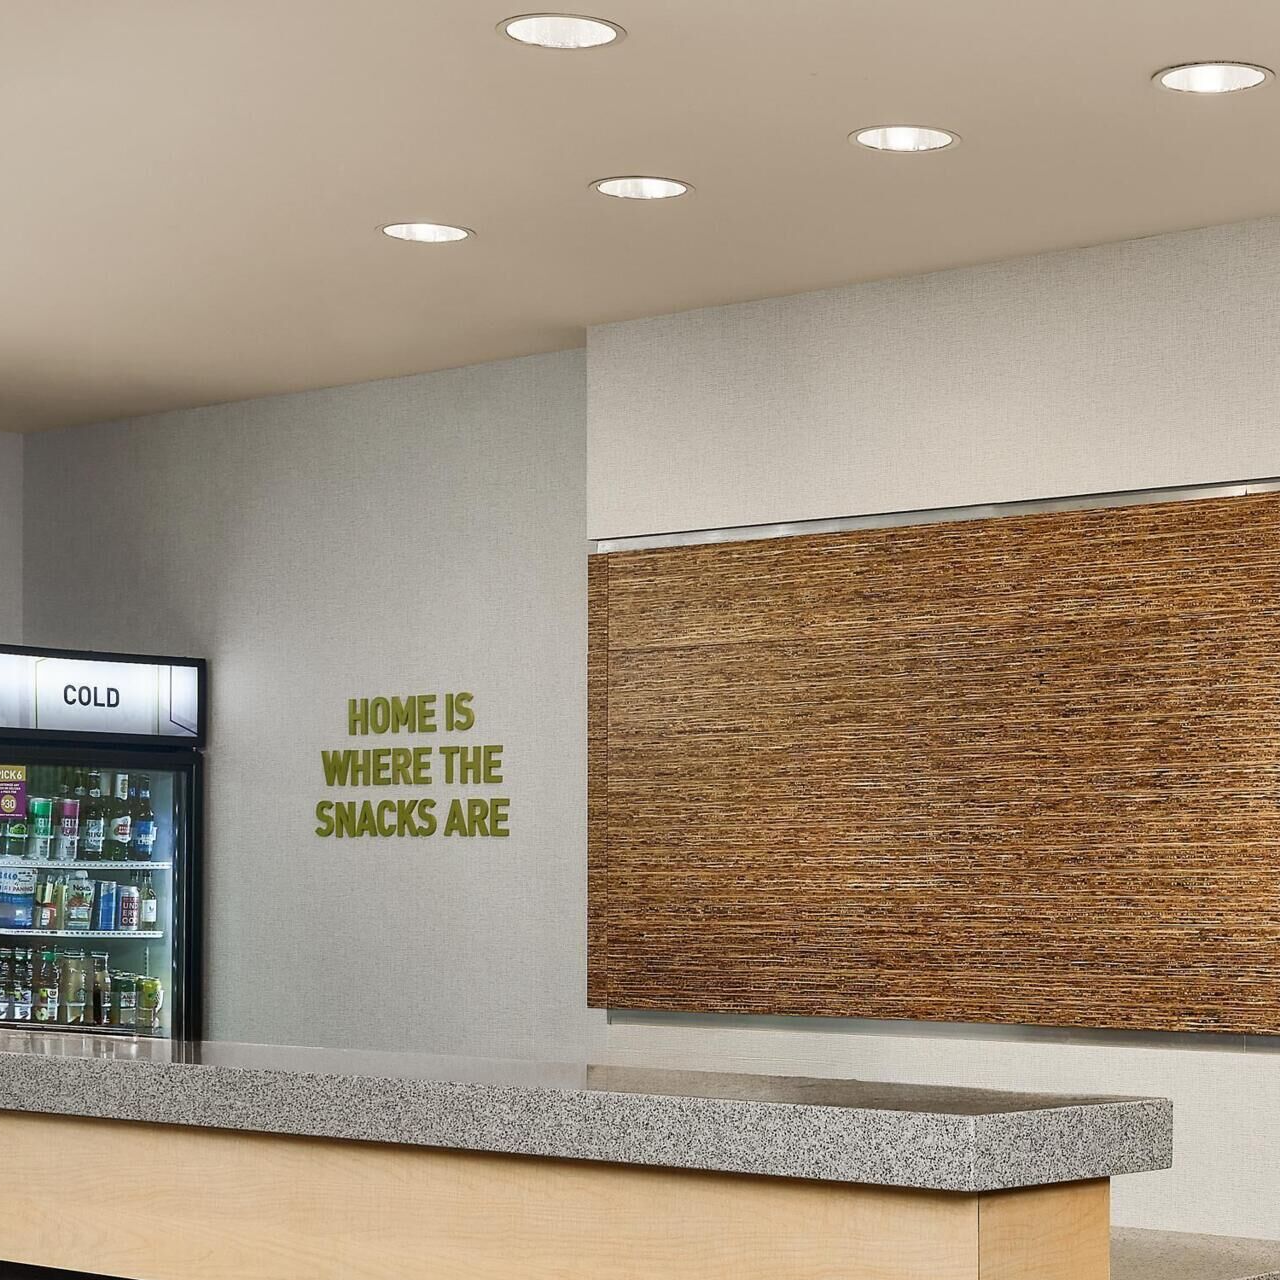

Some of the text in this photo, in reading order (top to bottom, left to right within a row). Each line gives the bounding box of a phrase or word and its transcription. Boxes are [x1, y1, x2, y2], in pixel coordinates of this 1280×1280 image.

[63, 684, 120, 708] COLD
[348, 692, 476, 736] HOME IS
[321, 744, 504, 787] WHERE THE
[315, 798, 511, 839] SNACKS ARE
